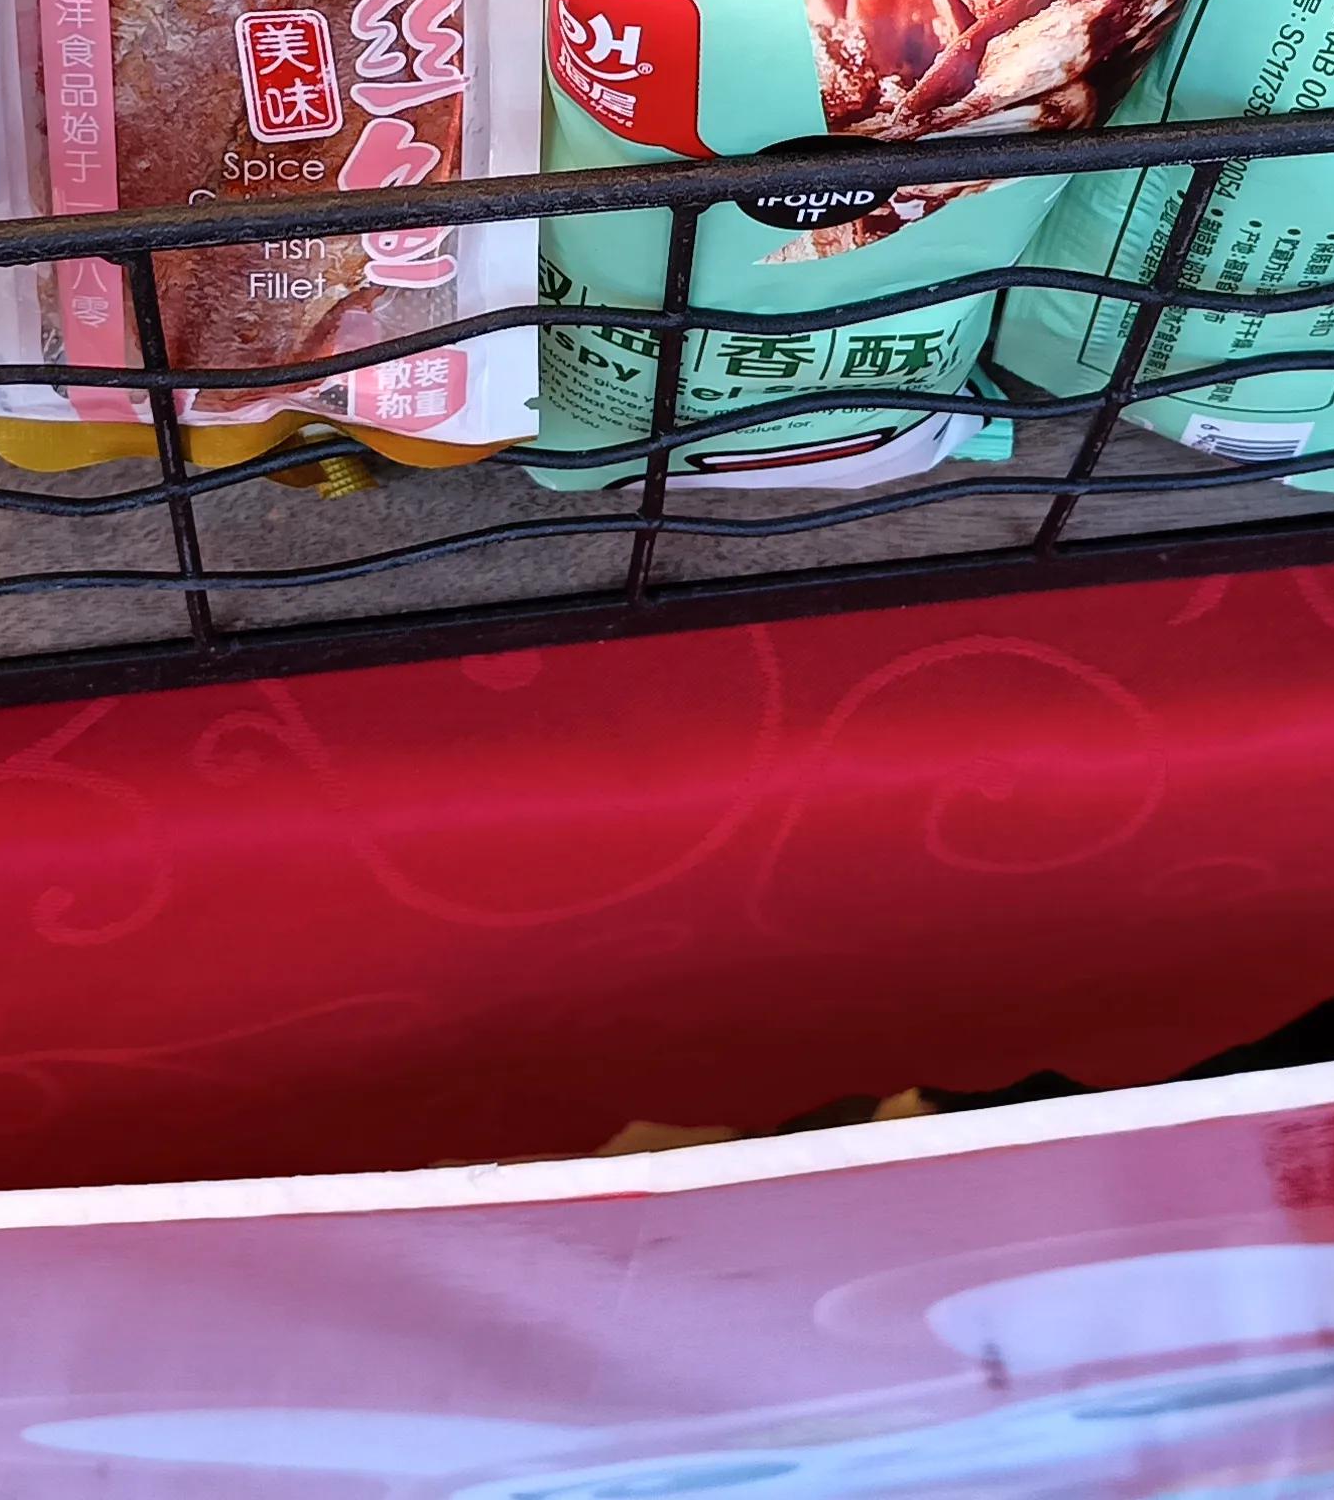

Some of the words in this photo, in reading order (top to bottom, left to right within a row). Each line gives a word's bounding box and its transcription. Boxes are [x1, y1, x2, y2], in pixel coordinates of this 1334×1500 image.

[254, 20, 323, 129] 美味
[222, 152, 325, 185] Spice
[797, 208, 827, 222] IT
[249, 273, 327, 299] Fillet
[376, 358, 449, 390] 散装
[376, 390, 448, 419] 称重
[610, 406, 651, 425] Ocea
